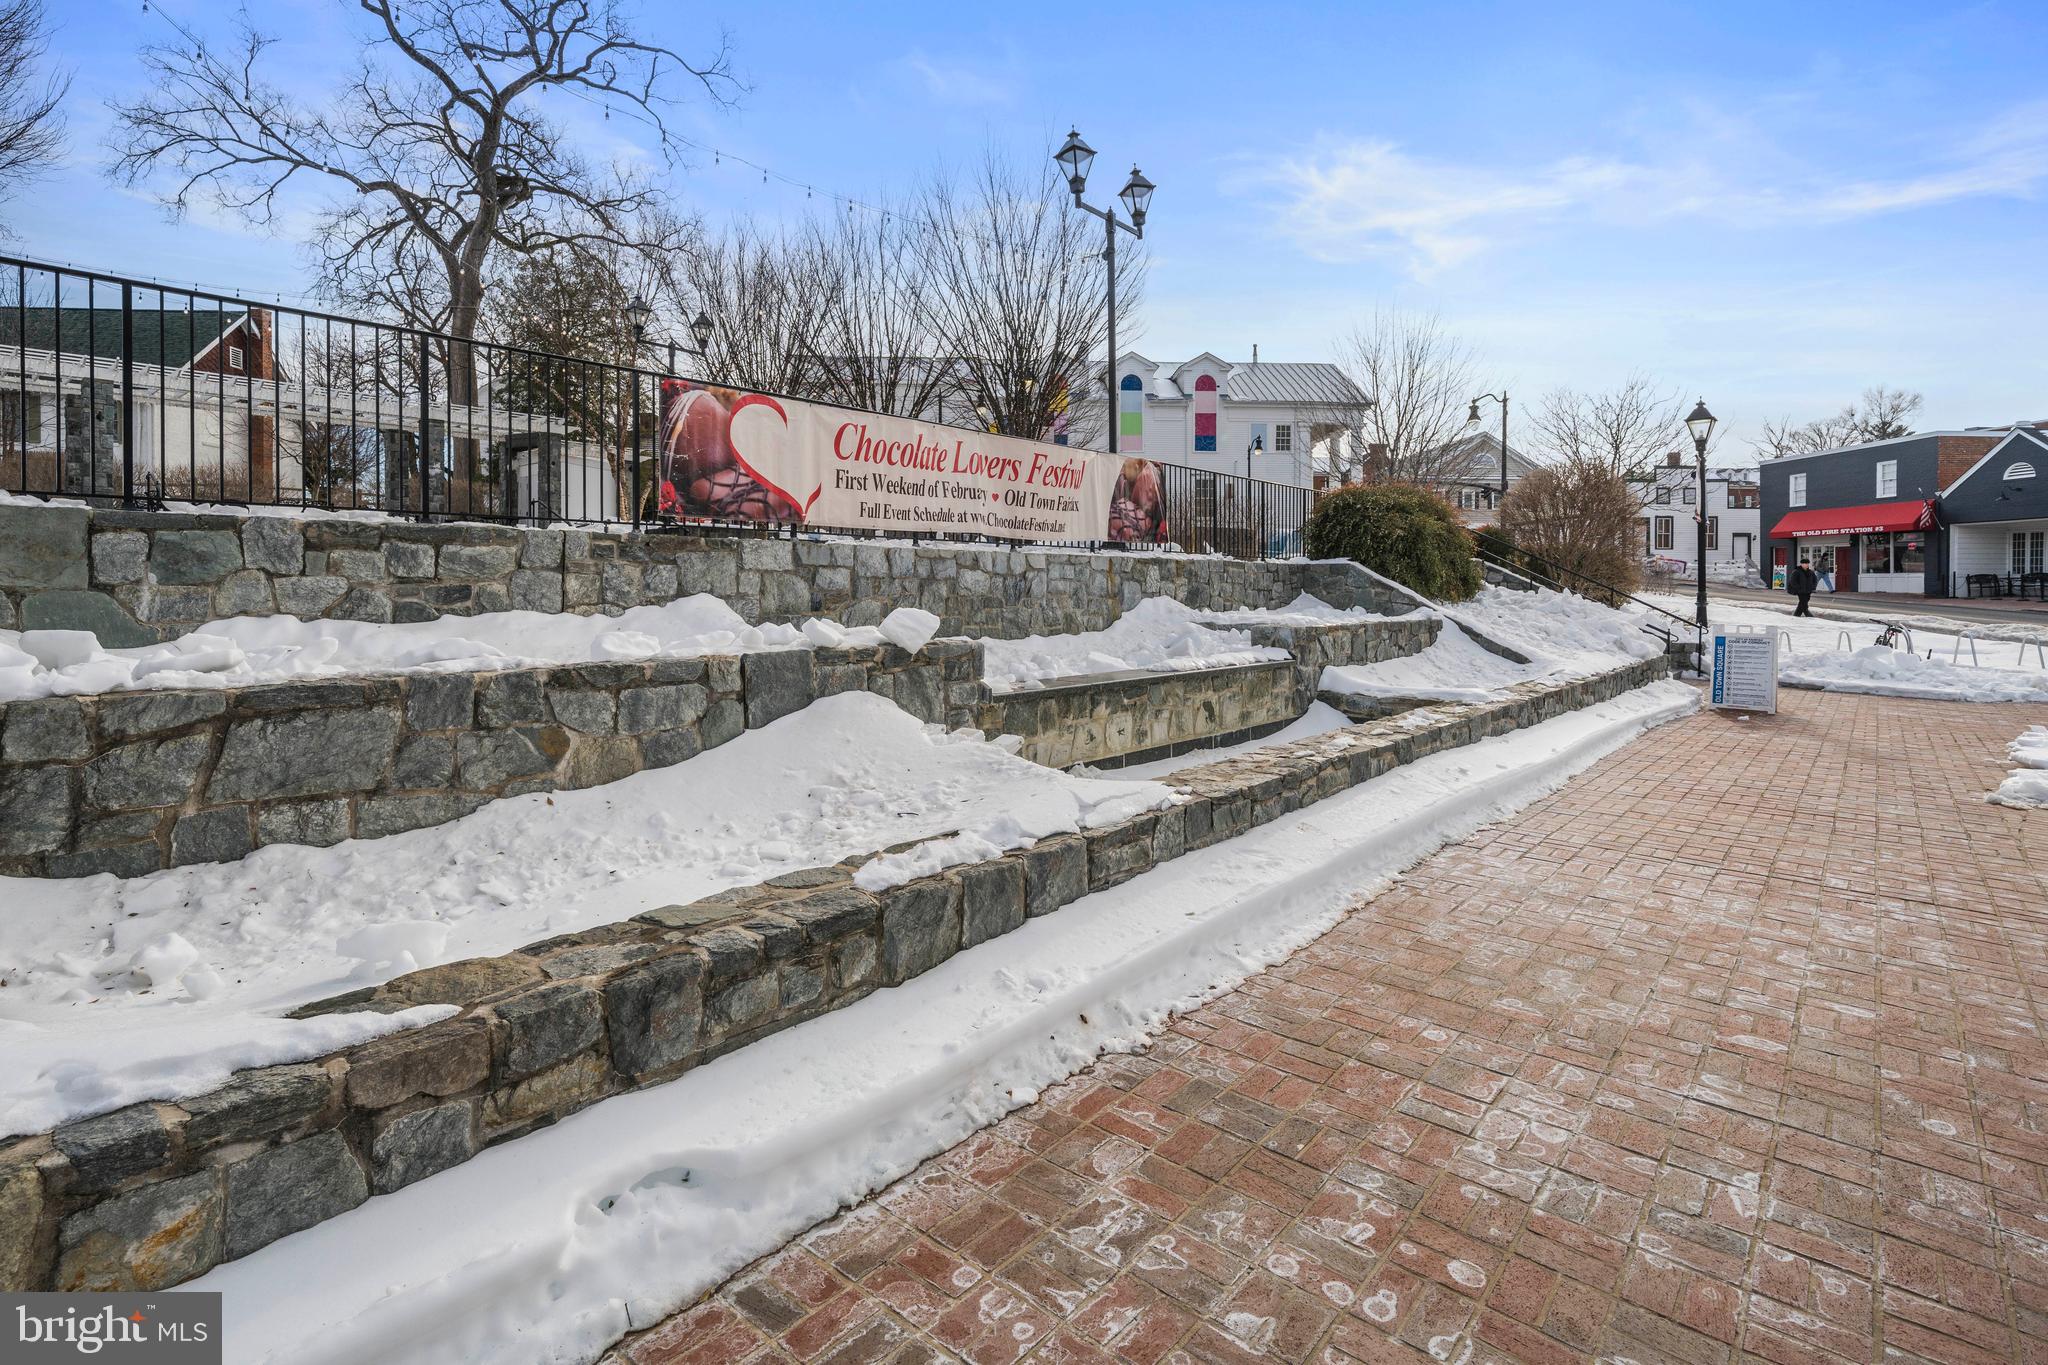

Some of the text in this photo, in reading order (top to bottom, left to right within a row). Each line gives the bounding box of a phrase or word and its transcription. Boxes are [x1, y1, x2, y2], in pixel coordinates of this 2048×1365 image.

[833, 422, 1086, 490] Chocolate Lovers Festival
[834, 468, 868, 491] First
[872, 472, 926, 497] Weekend
[928, 480, 940, 498] of
[1004, 488, 1027, 508] Old
[1029, 491, 1055, 511] Town
[859, 501, 881, 519] Full
[883, 503, 911, 521] Event
[913, 505, 955, 523] Schedule
[957, 509, 968, 523] at
[1840, 526, 1873, 534] STATION
